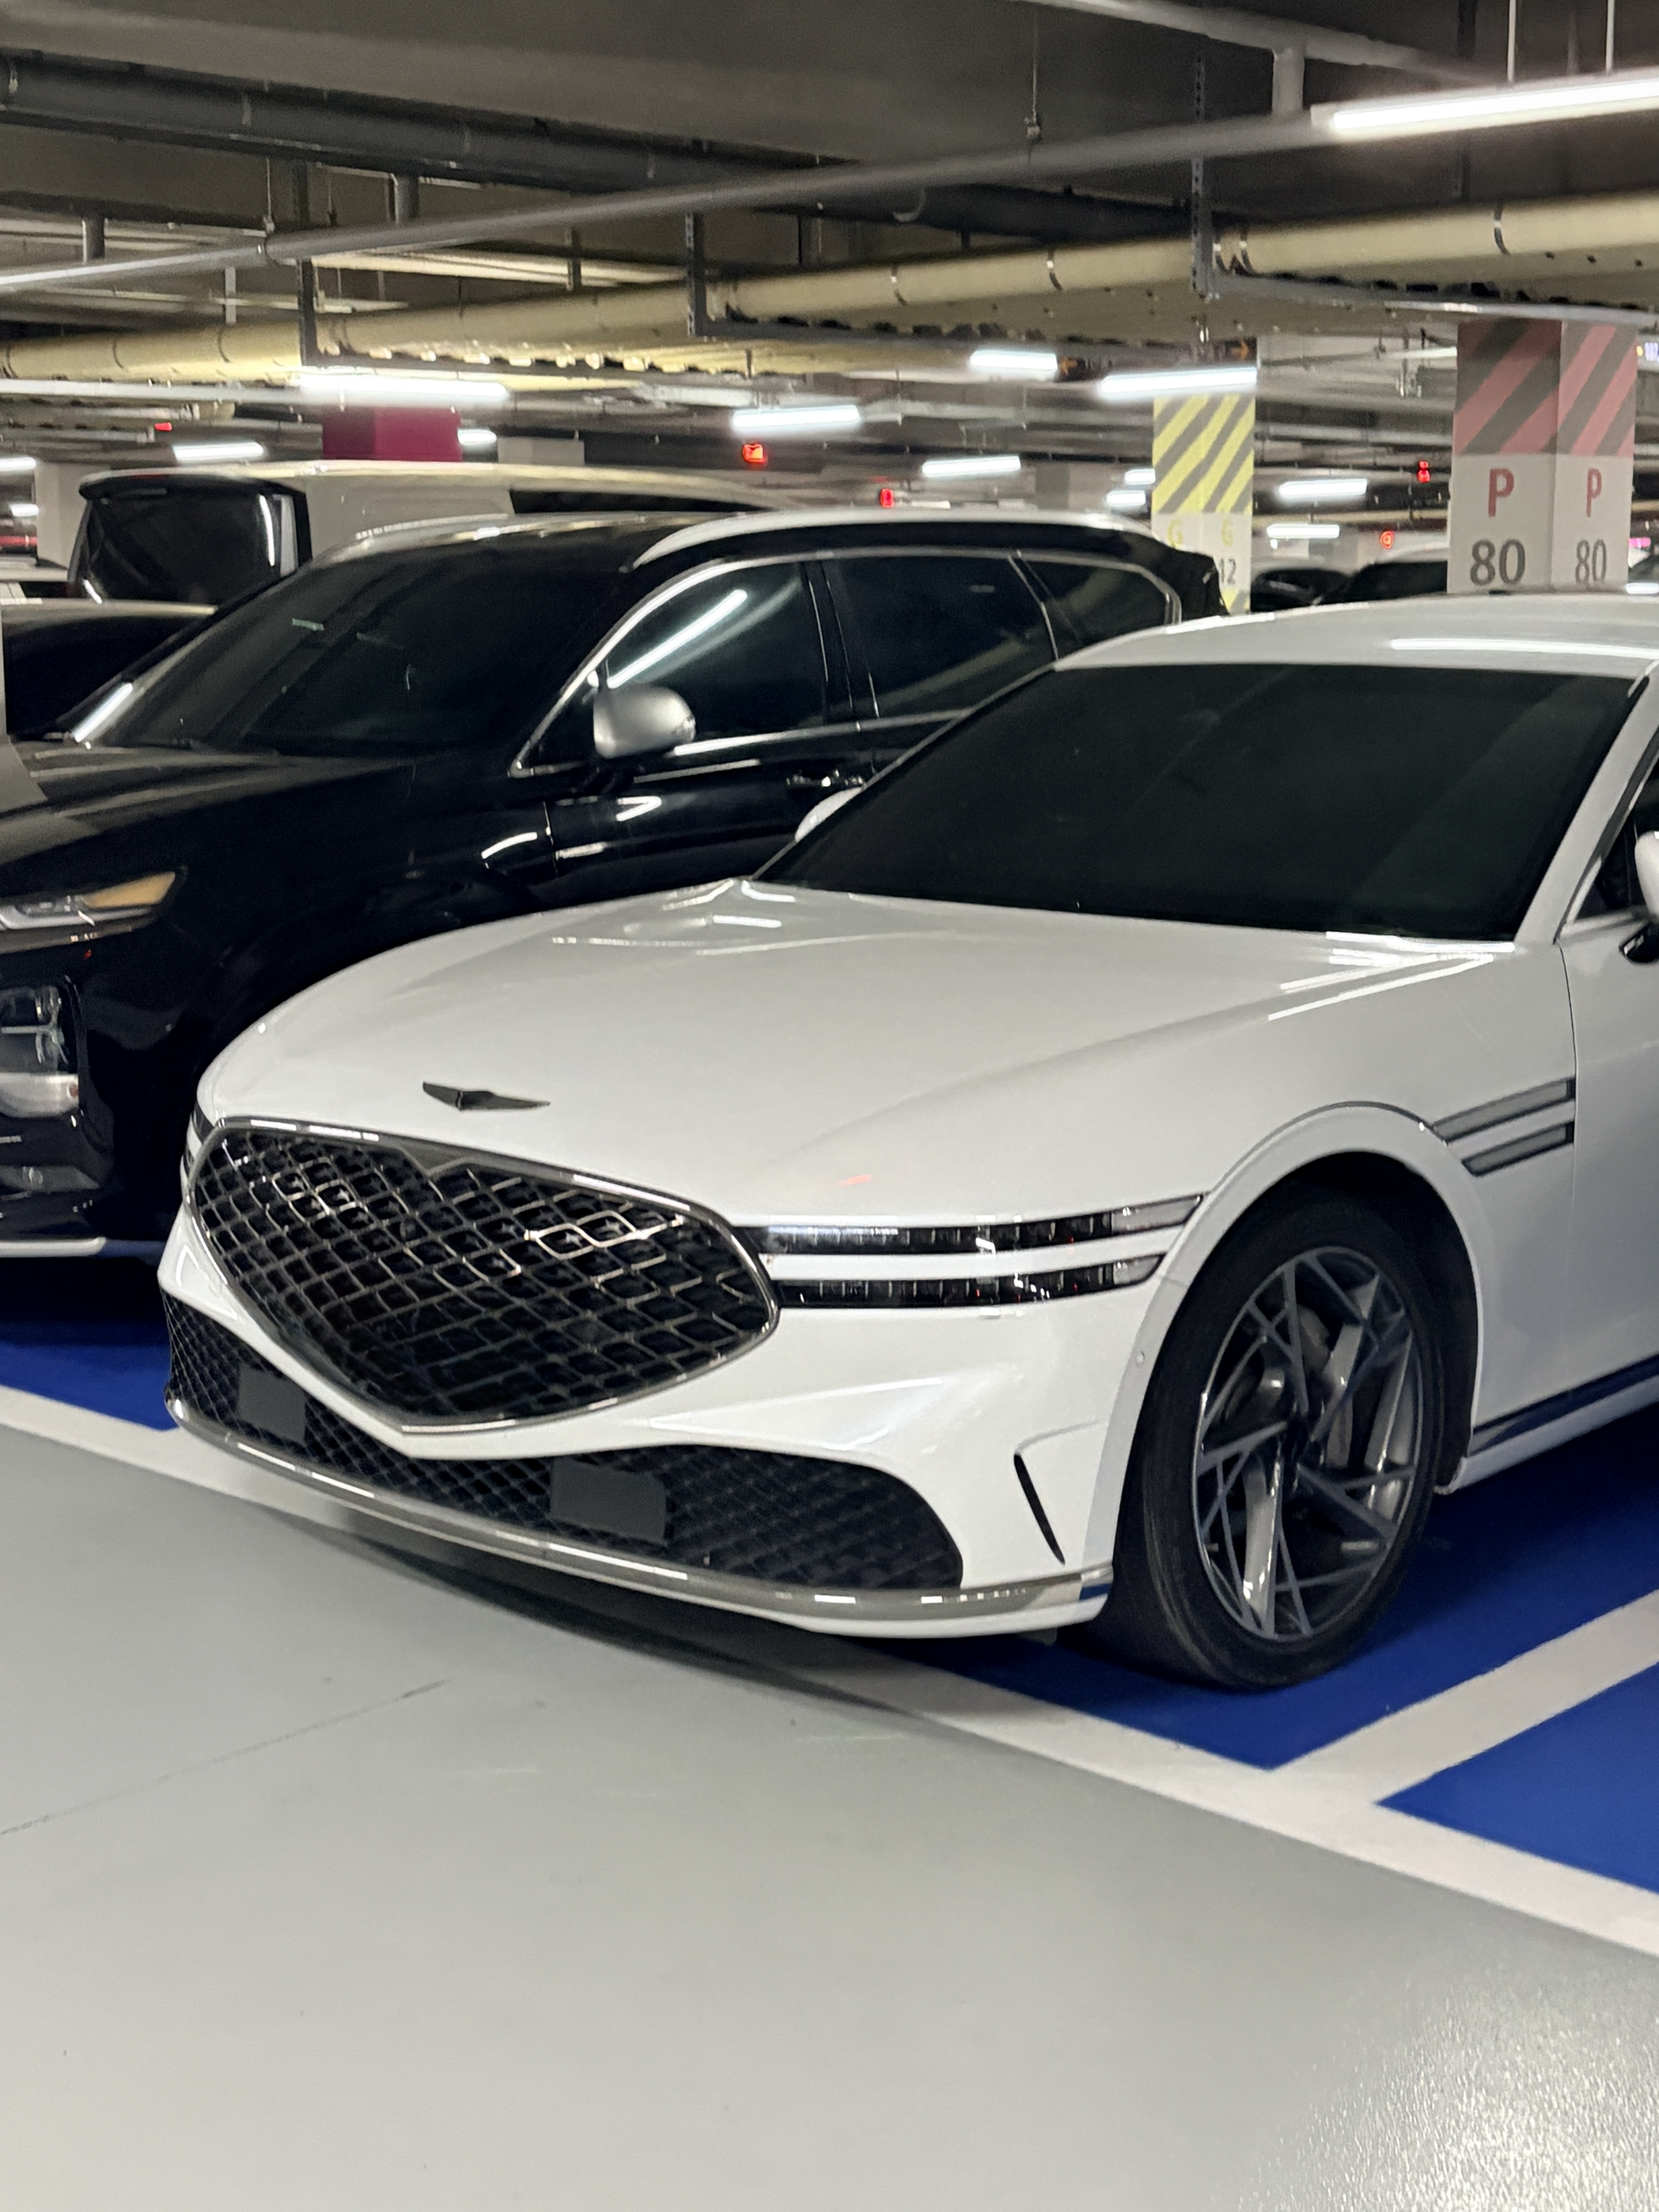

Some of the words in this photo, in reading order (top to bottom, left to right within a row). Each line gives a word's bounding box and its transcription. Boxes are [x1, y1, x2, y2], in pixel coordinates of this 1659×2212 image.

[1488, 468, 1515, 517] P
[1586, 468, 1602, 517] P
[1167, 519, 1183, 548] G
[1470, 539, 1525, 585] 80
[1575, 539, 1607, 582] 80
